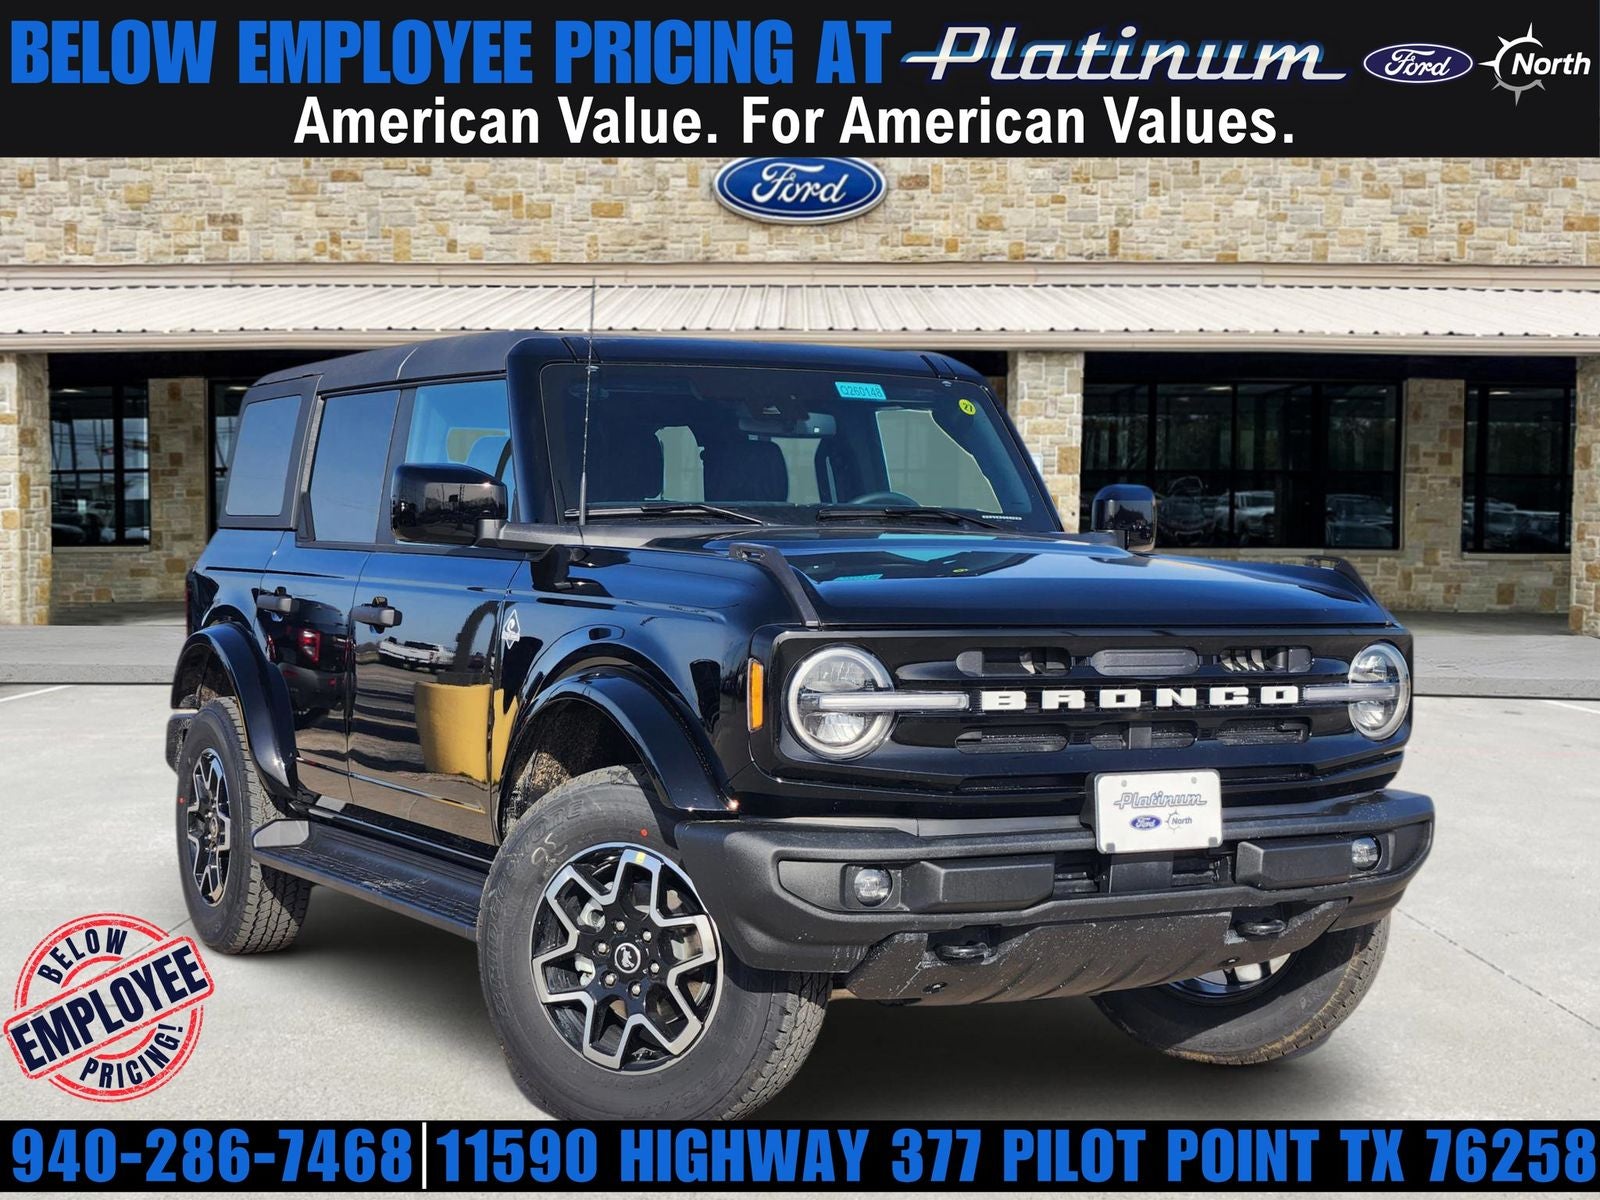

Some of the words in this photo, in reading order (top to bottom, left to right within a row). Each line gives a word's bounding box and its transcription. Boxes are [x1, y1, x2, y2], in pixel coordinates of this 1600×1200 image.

[751, 162, 849, 204] Ford
[981, 686, 1299, 711] BRONCO
[1113, 790, 1208, 810] Platinum
[1171, 815, 1193, 826] North
